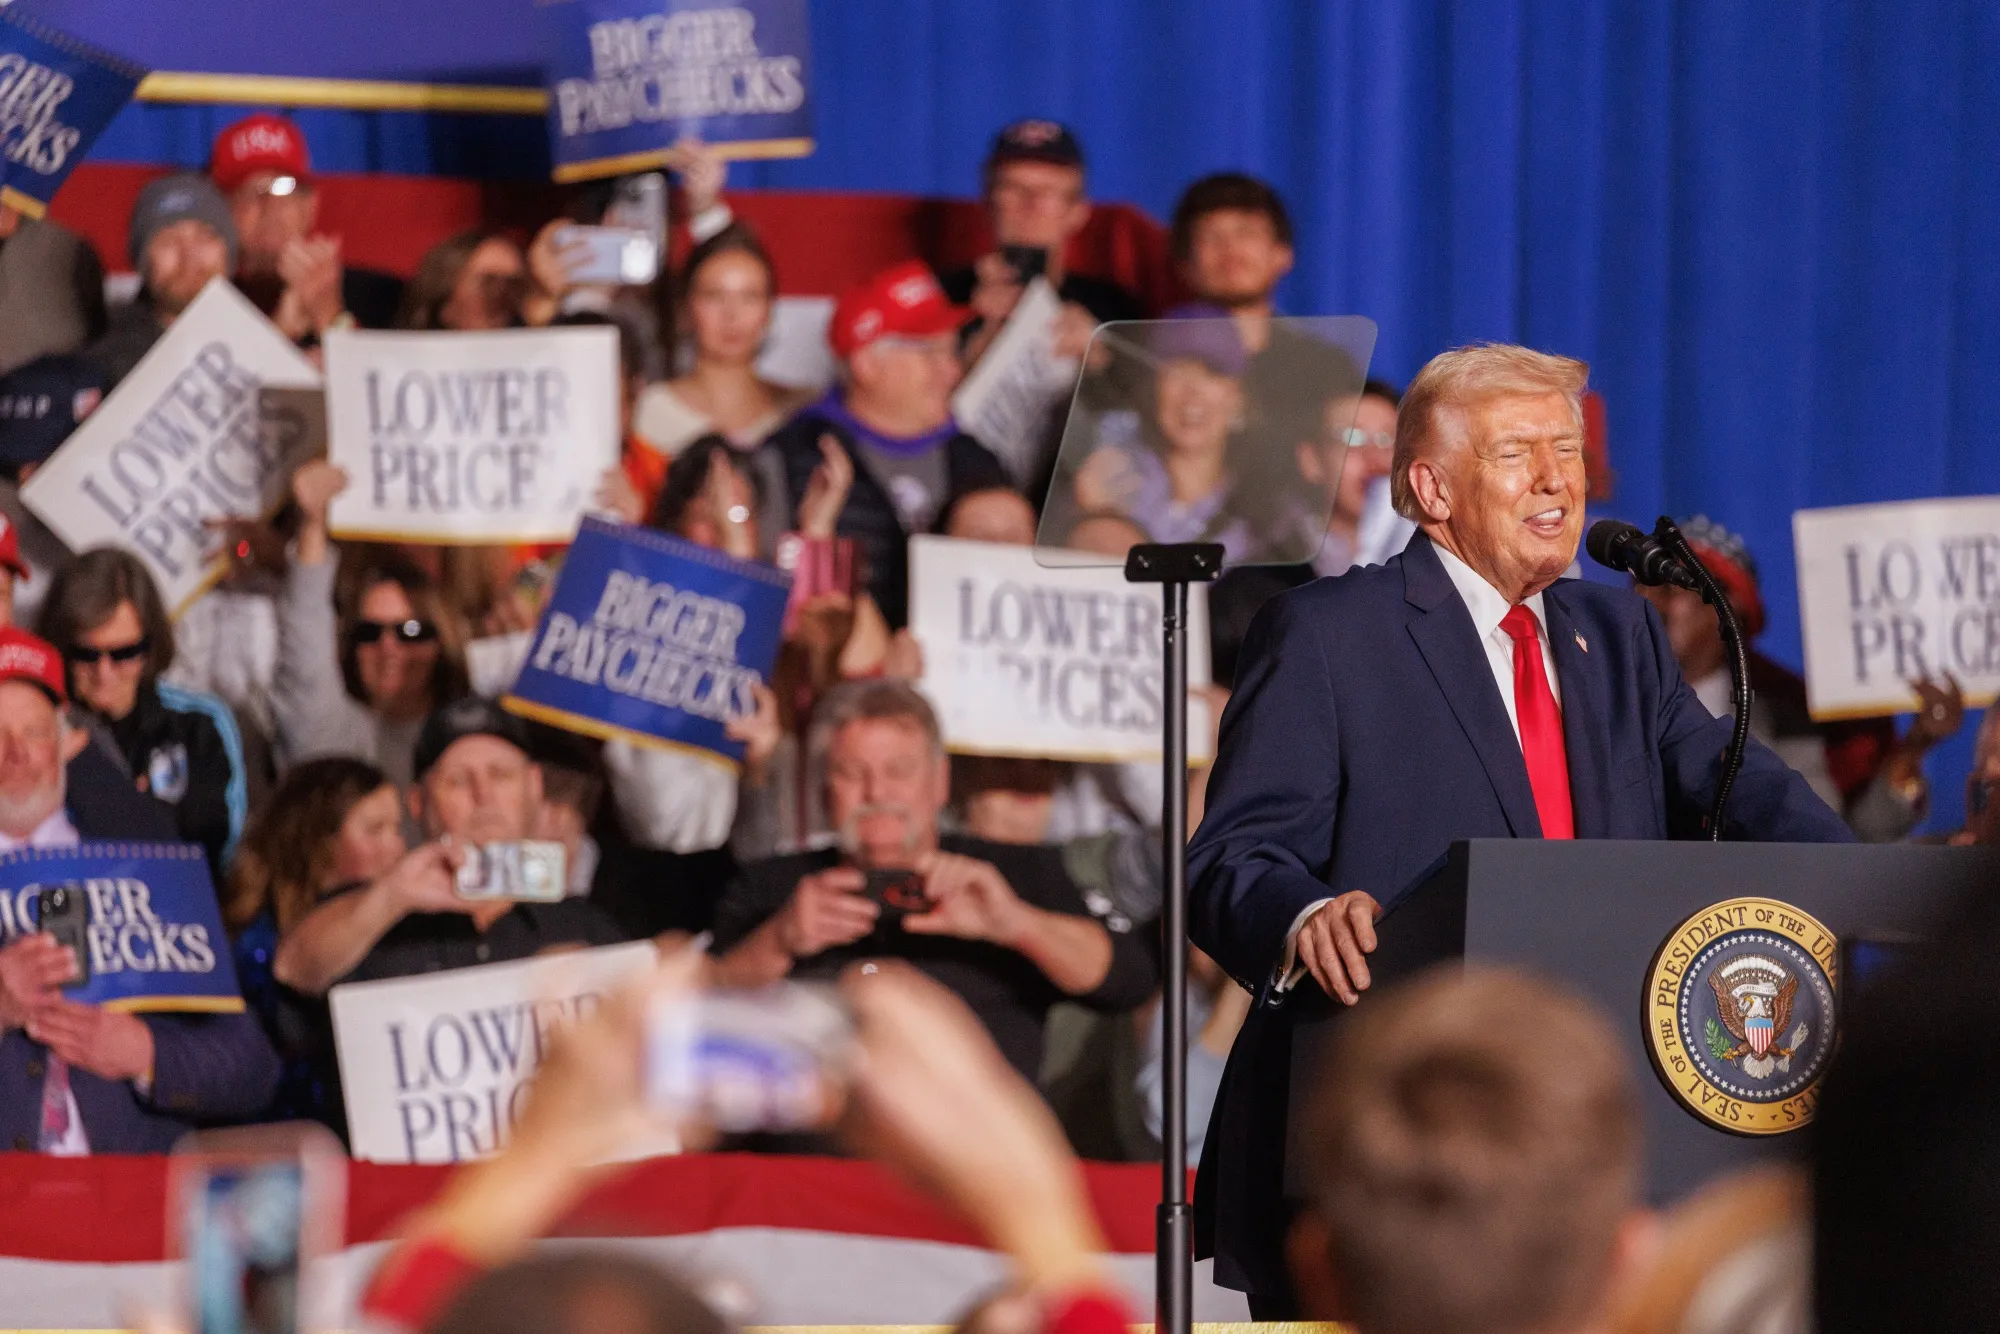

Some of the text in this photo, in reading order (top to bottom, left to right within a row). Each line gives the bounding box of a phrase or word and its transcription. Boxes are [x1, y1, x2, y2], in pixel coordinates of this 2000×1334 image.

[589, 8, 757, 77] BIGGER
[557, 56, 804, 135] PAYCHECKS
[80, 340, 262, 528] LOWER
[364, 366, 570, 438] LOWER
[595, 568, 746, 666] BIGGER
[957, 577, 1162, 658] LOWER
[1755, 908, 1775, 923] OF
[1779, 914, 1806, 937] THE
[1657, 906, 1748, 1009] PRESIDENT
[1660, 1018, 1677, 1050] THE
[1670, 1053, 1687, 1074] OF
[1687, 1072, 1743, 1122] SEAL
